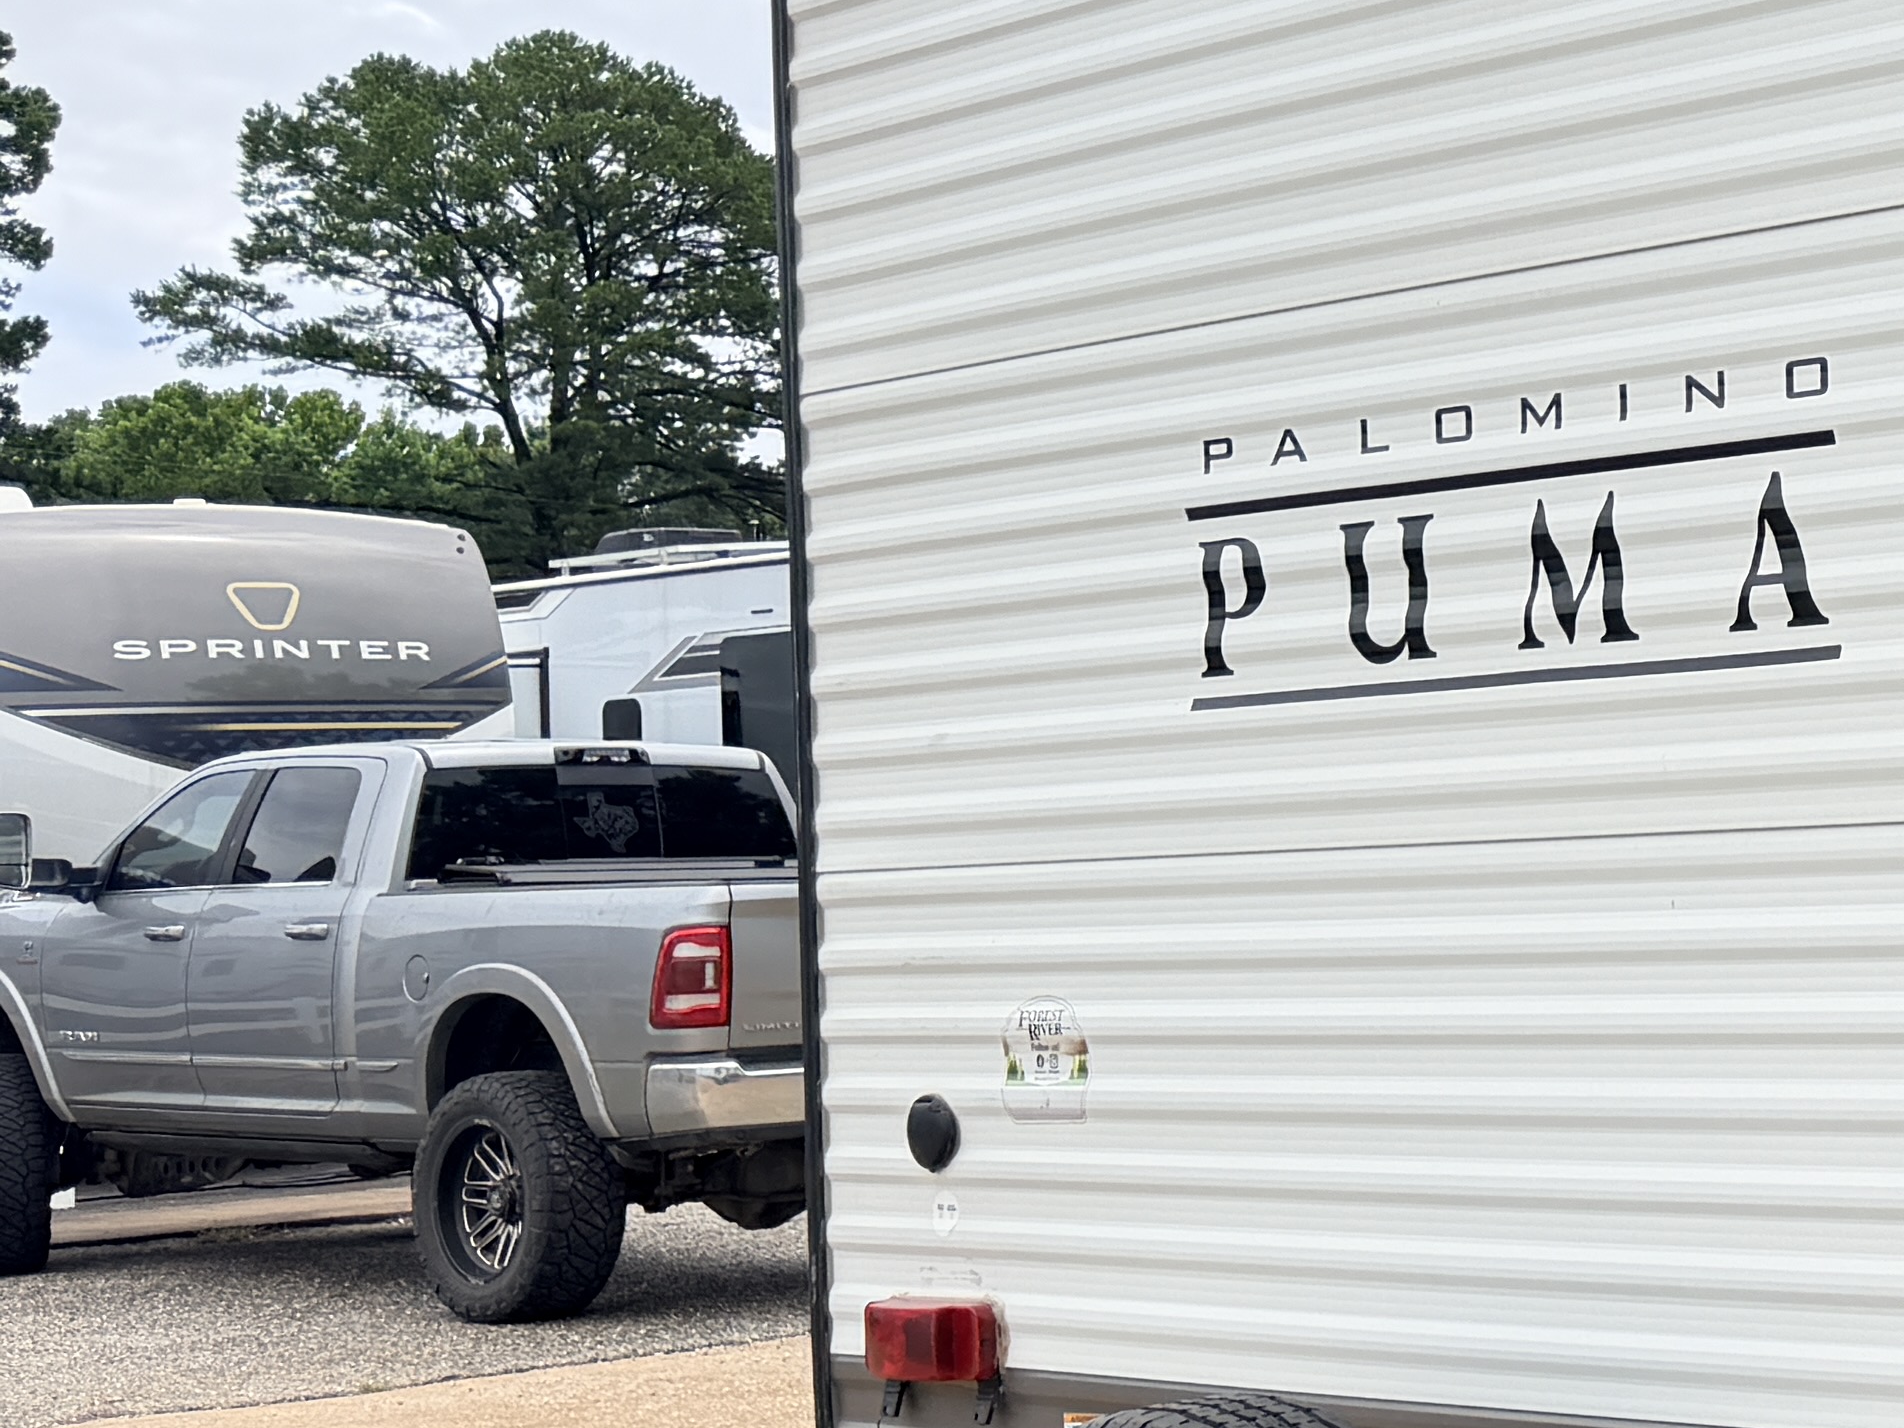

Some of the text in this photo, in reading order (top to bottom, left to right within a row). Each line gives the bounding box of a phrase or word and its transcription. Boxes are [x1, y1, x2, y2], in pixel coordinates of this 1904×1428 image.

[1201, 356, 1829, 475] PALOMINO
[1197, 470, 1830, 679] PUMA
[112, 638, 431, 661] SPRINTER
[1018, 1009, 1065, 1028] FOREST
[1028, 1022, 1063, 1041] RIVER
